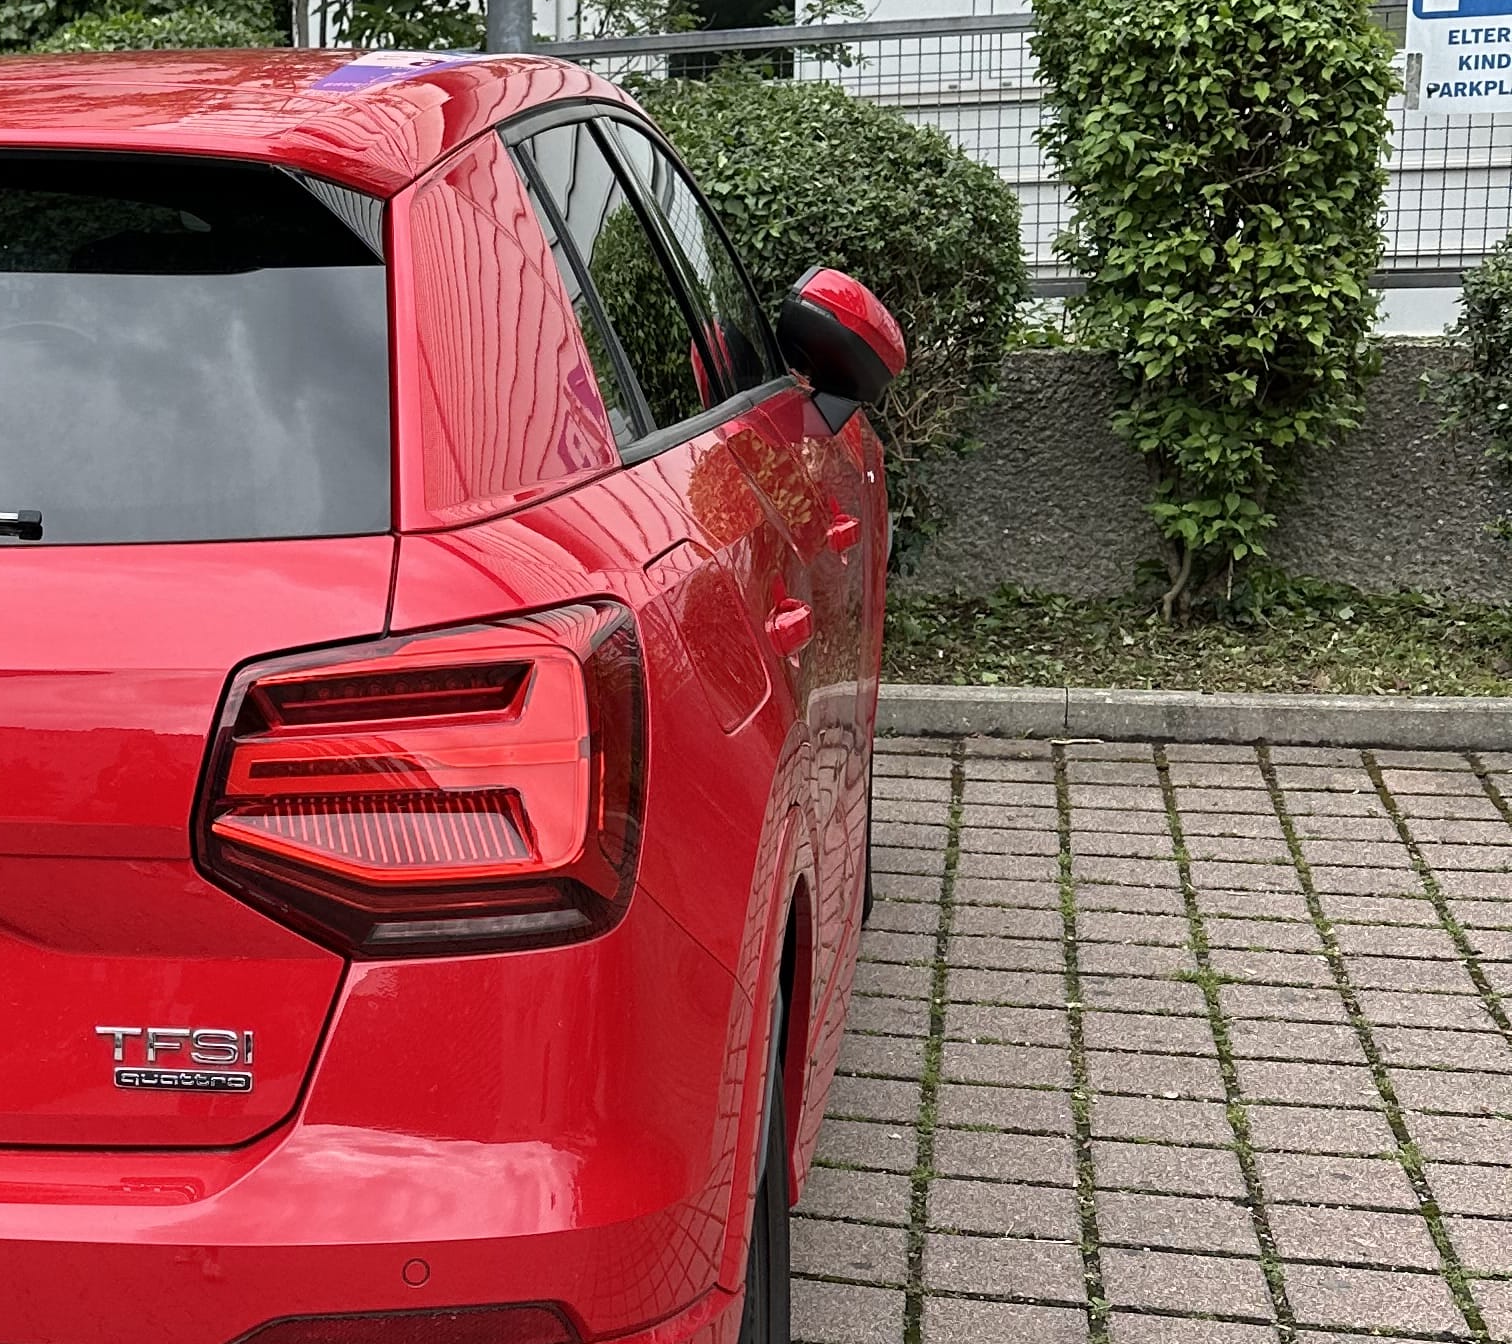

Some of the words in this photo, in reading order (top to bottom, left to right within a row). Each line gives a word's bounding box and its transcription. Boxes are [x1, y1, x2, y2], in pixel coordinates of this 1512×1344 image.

[1426, 79, 1512, 99] PARKPL
[95, 1025, 254, 1066] TFSI
[120, 1071, 247, 1088] quattro
